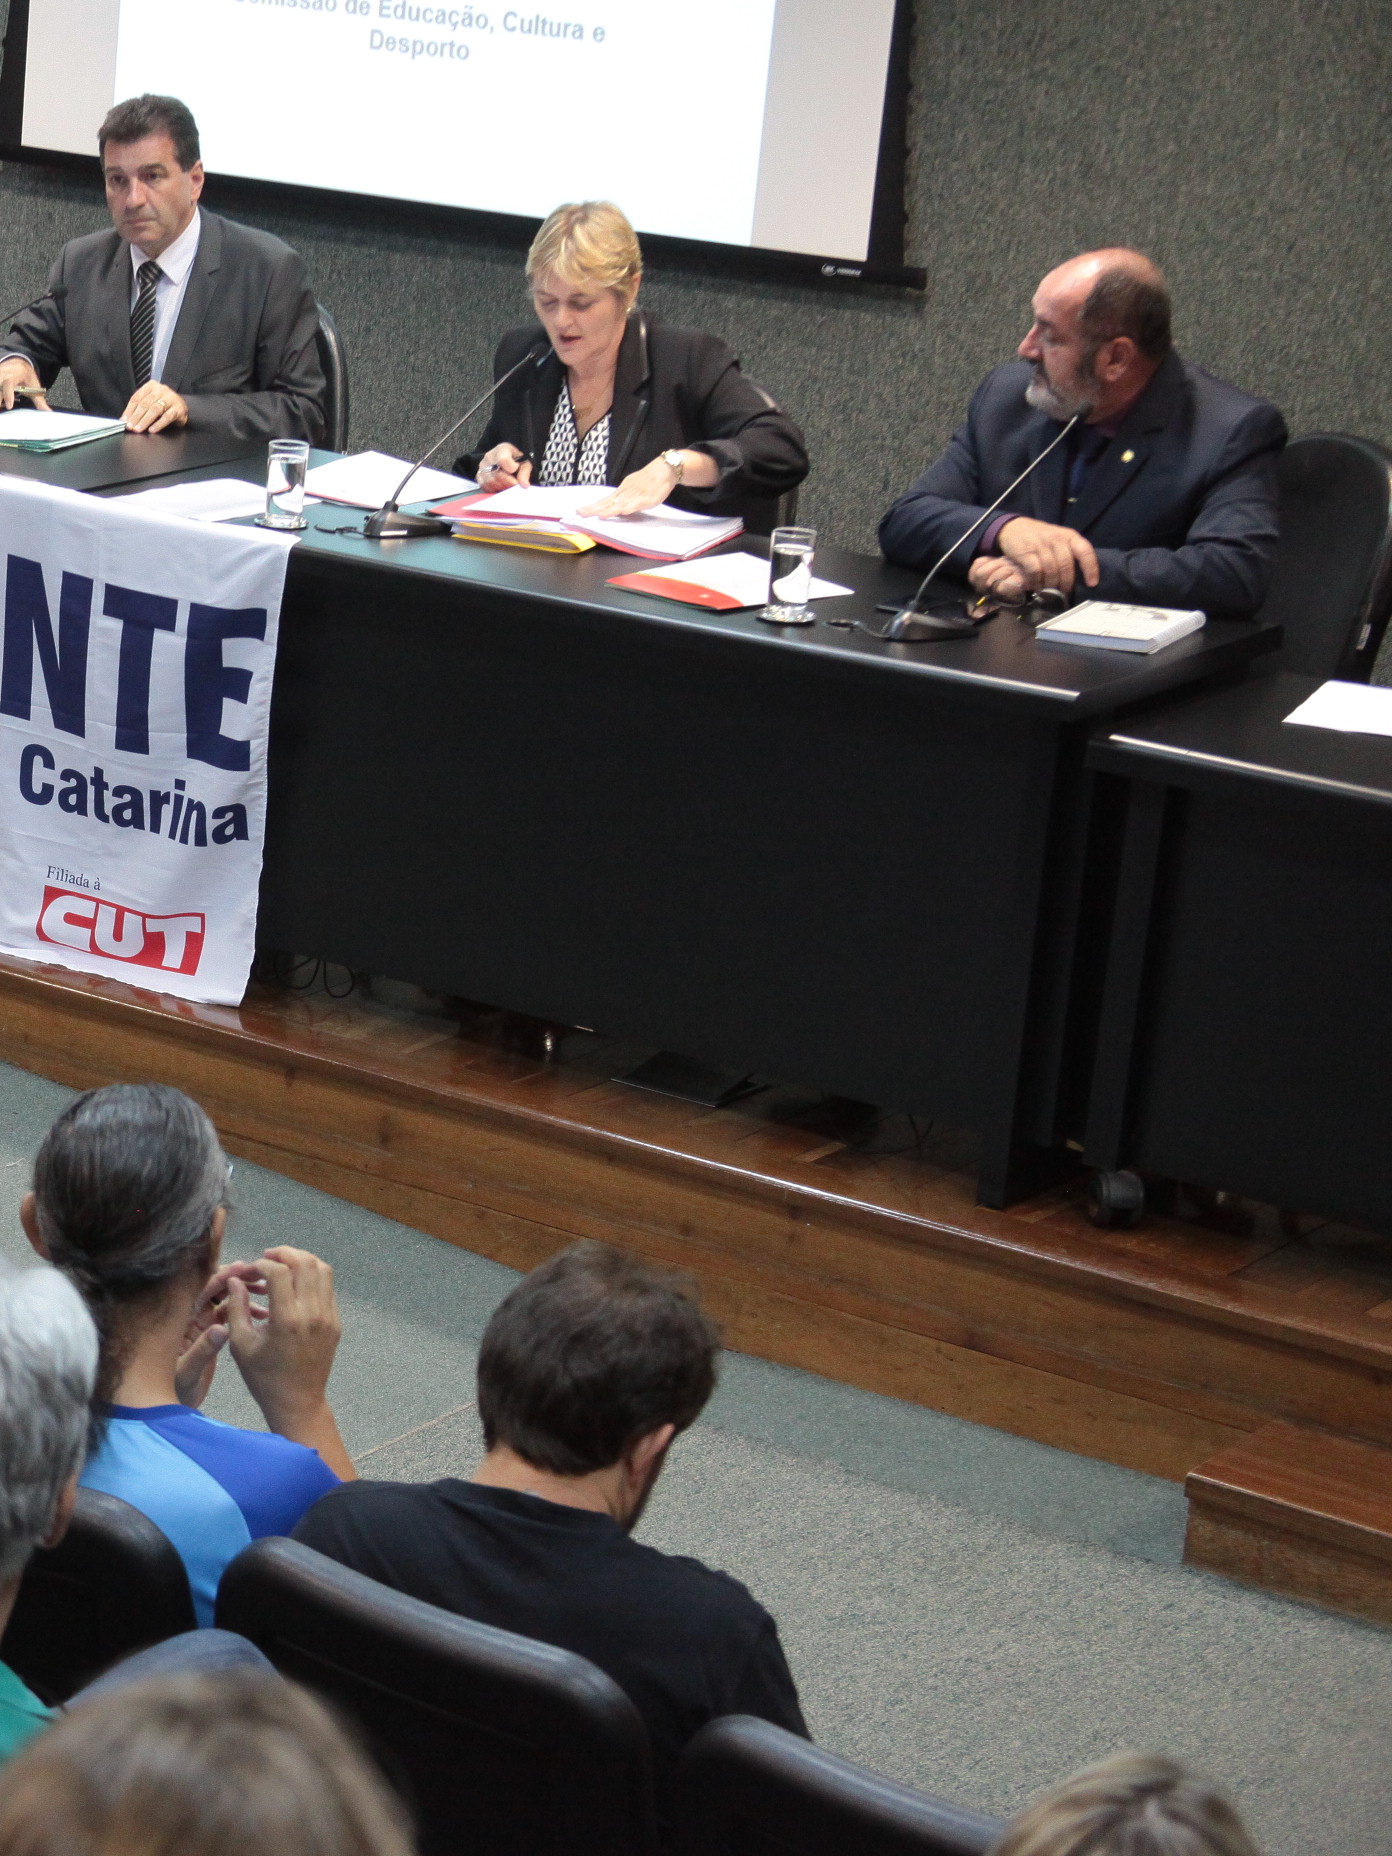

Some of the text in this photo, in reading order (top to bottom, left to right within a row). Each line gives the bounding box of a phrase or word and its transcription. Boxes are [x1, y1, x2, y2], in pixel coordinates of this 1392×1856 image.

[235, 0, 606, 44] ssão de Educação, Cultura e
[369, 28, 471, 62] Desporto
[18, 743, 250, 848] Catarina
[46, 864, 102, 891] Filiada à
[41, 894, 203, 970] CUT
